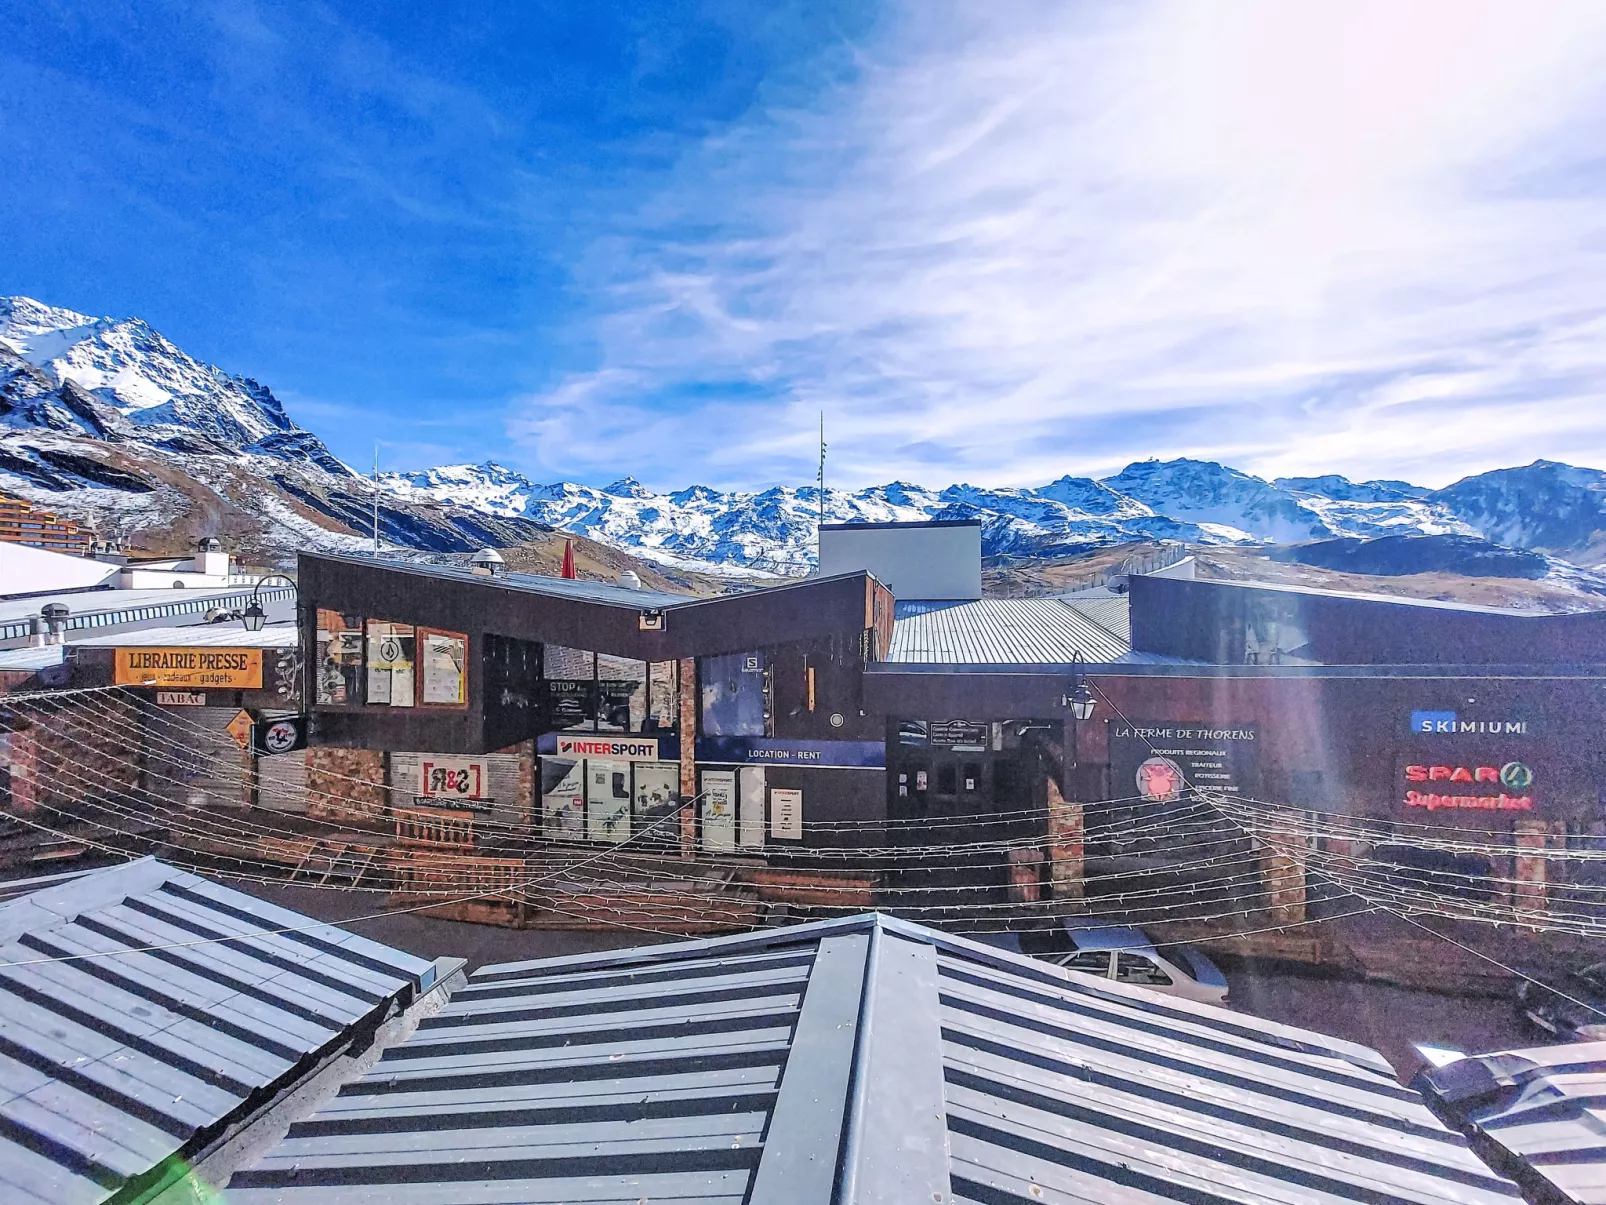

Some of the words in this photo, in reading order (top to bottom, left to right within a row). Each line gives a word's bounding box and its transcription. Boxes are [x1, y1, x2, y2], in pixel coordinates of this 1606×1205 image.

[129, 652, 196, 668] LIBRAIRIE
[199, 653, 248, 670] PRESSE
[200, 673, 232, 685] gadgets
[550, 682, 575, 691] STOP
[160, 692, 204, 704] TABAC
[1421, 720, 1523, 733] SKIMIUM
[1115, 728, 1129, 738] LA
[1134, 729, 1172, 738] FERME
[1176, 729, 1193, 739] DE
[1197, 730, 1255, 740] THORENS
[573, 742, 654, 756] INTERSPORT
[748, 750, 789, 759] LOCATION
[797, 751, 821, 760] RENT
[1405, 765, 1498, 782] SPAR
